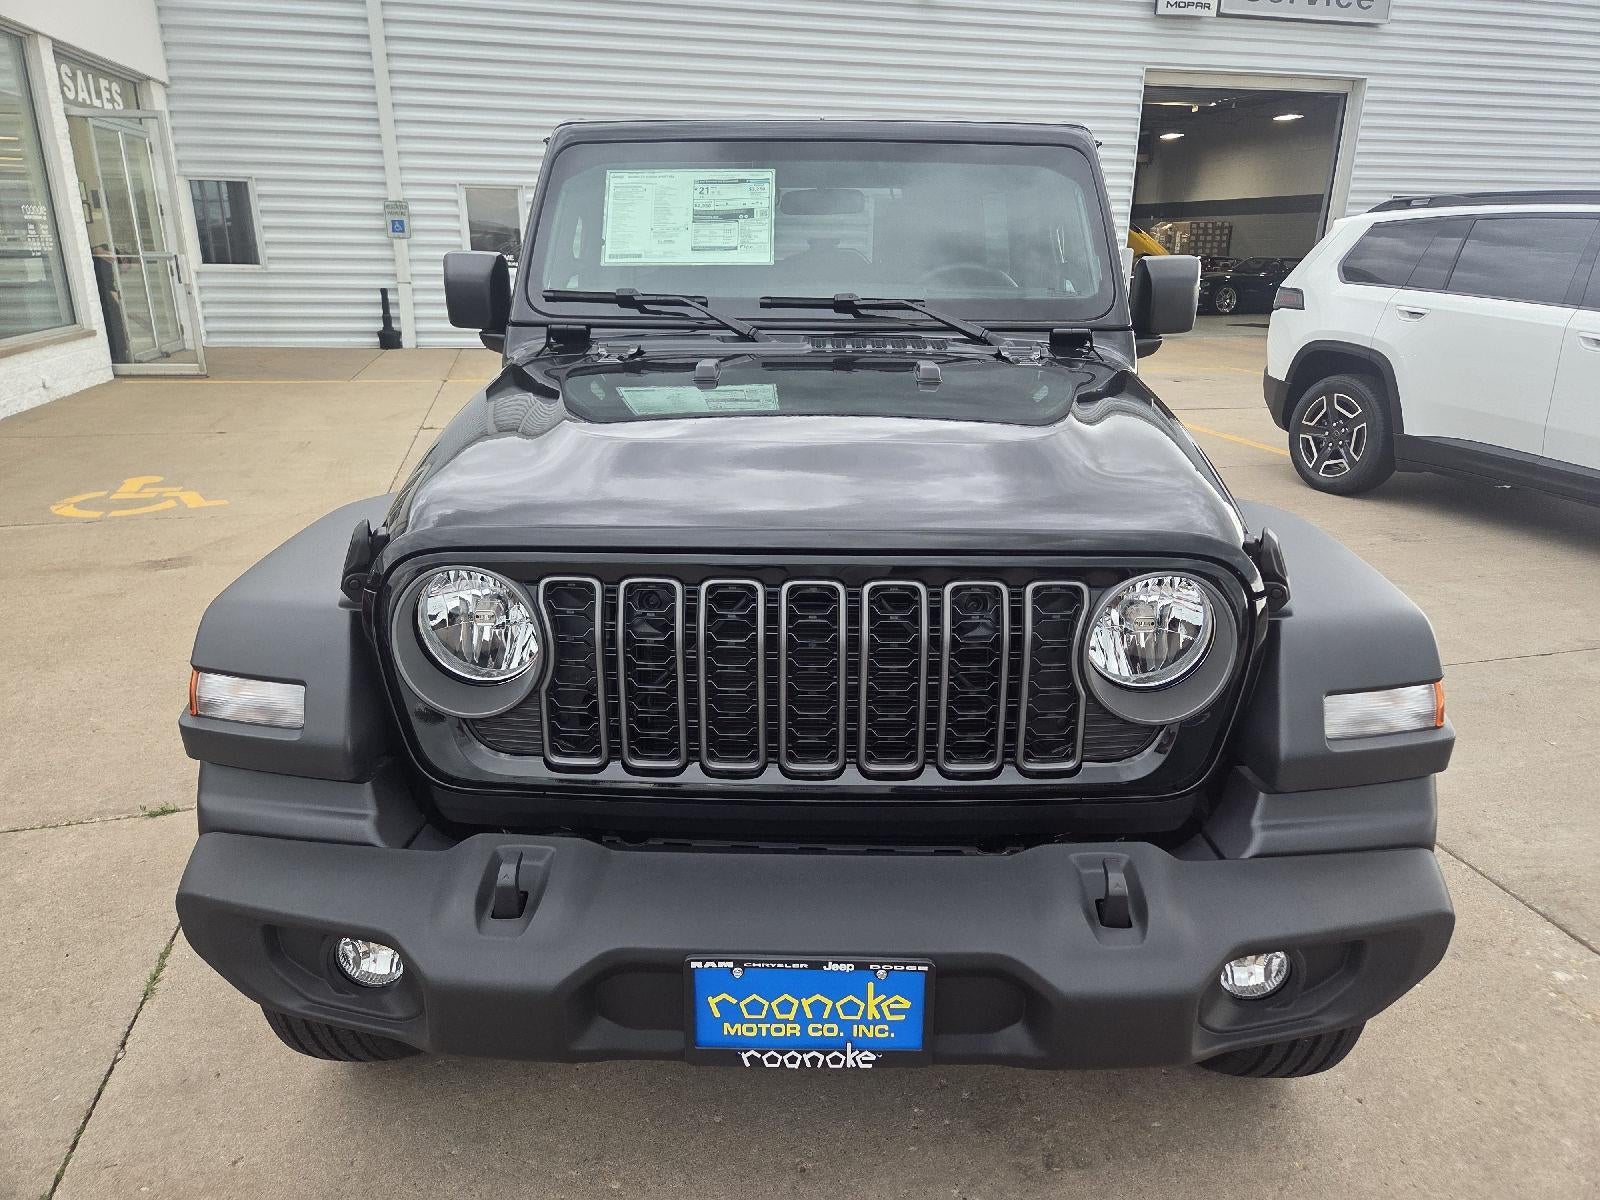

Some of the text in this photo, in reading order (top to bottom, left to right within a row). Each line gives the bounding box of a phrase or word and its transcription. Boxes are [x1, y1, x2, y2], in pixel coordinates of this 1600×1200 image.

[1166, 0, 1211, 10] MOPAR
[60, 63, 124, 110] SALES
[691, 961, 734, 969] RAM
[823, 961, 855, 973] Jeep
[869, 964, 929, 972] DODGE
[708, 982, 912, 1021] roanoke
[723, 1022, 895, 1038] MOTOR CO. INC.
[742, 1042, 876, 1069] roanoke
